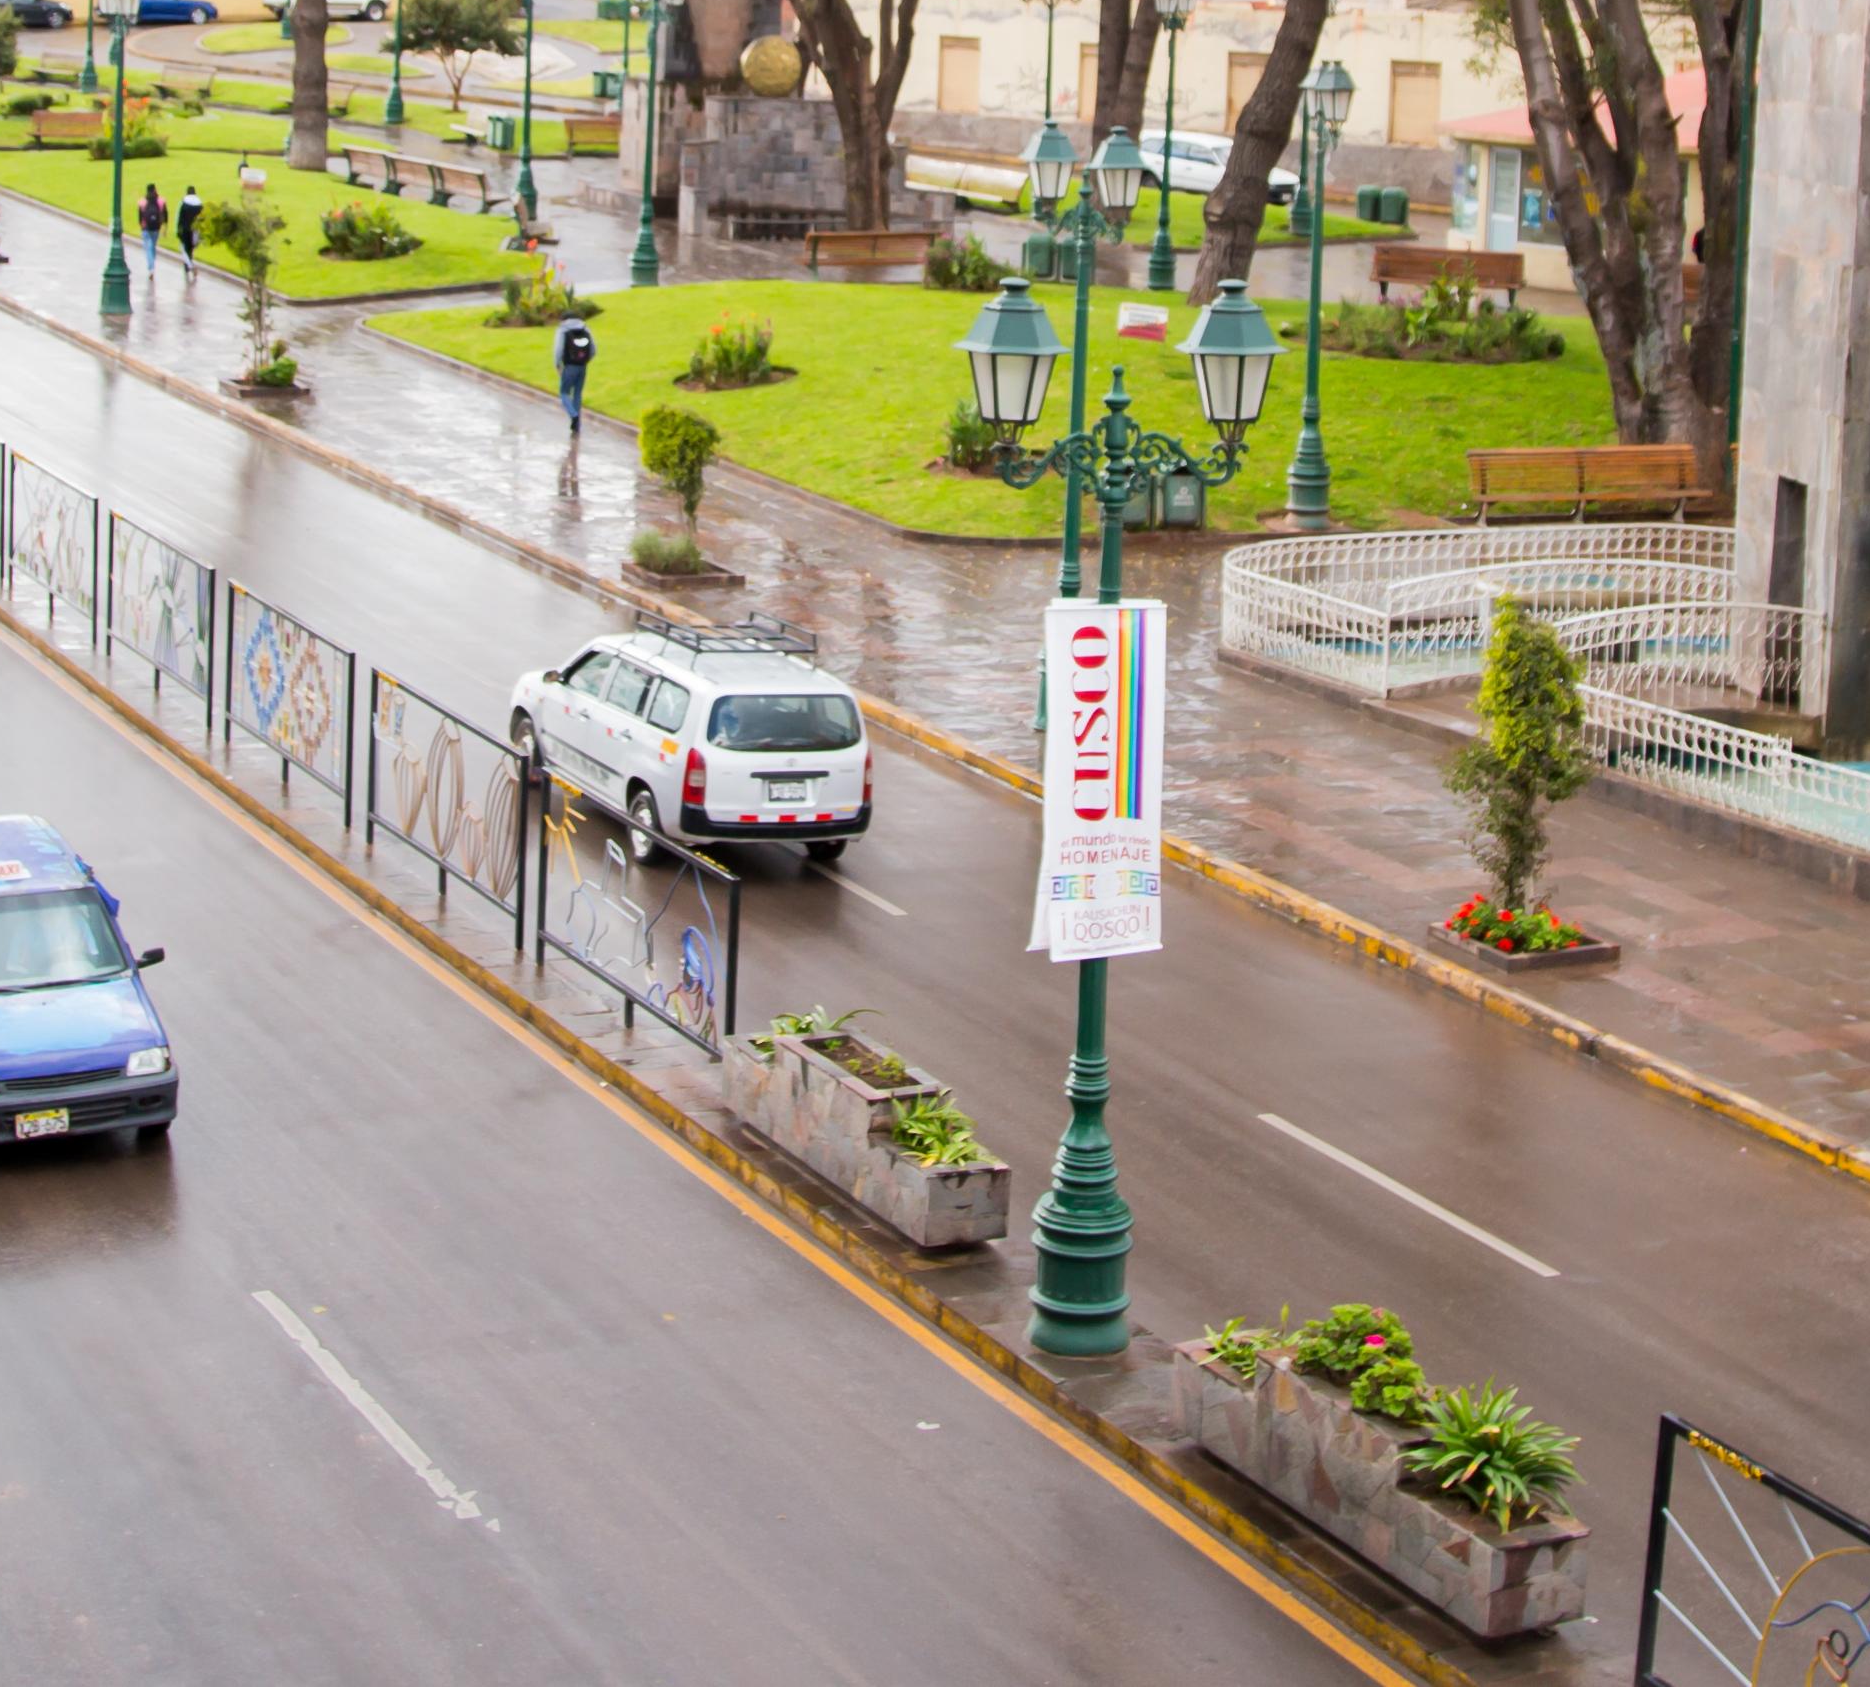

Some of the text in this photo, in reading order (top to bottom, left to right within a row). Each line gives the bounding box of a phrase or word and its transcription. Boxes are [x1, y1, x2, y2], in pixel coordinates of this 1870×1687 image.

[1071, 625, 1110, 822] CUSCO
[1072, 833, 1116, 846] mundo
[1060, 845, 1152, 865] HOMENAJE
[1074, 916, 1139, 942] QOSQO
